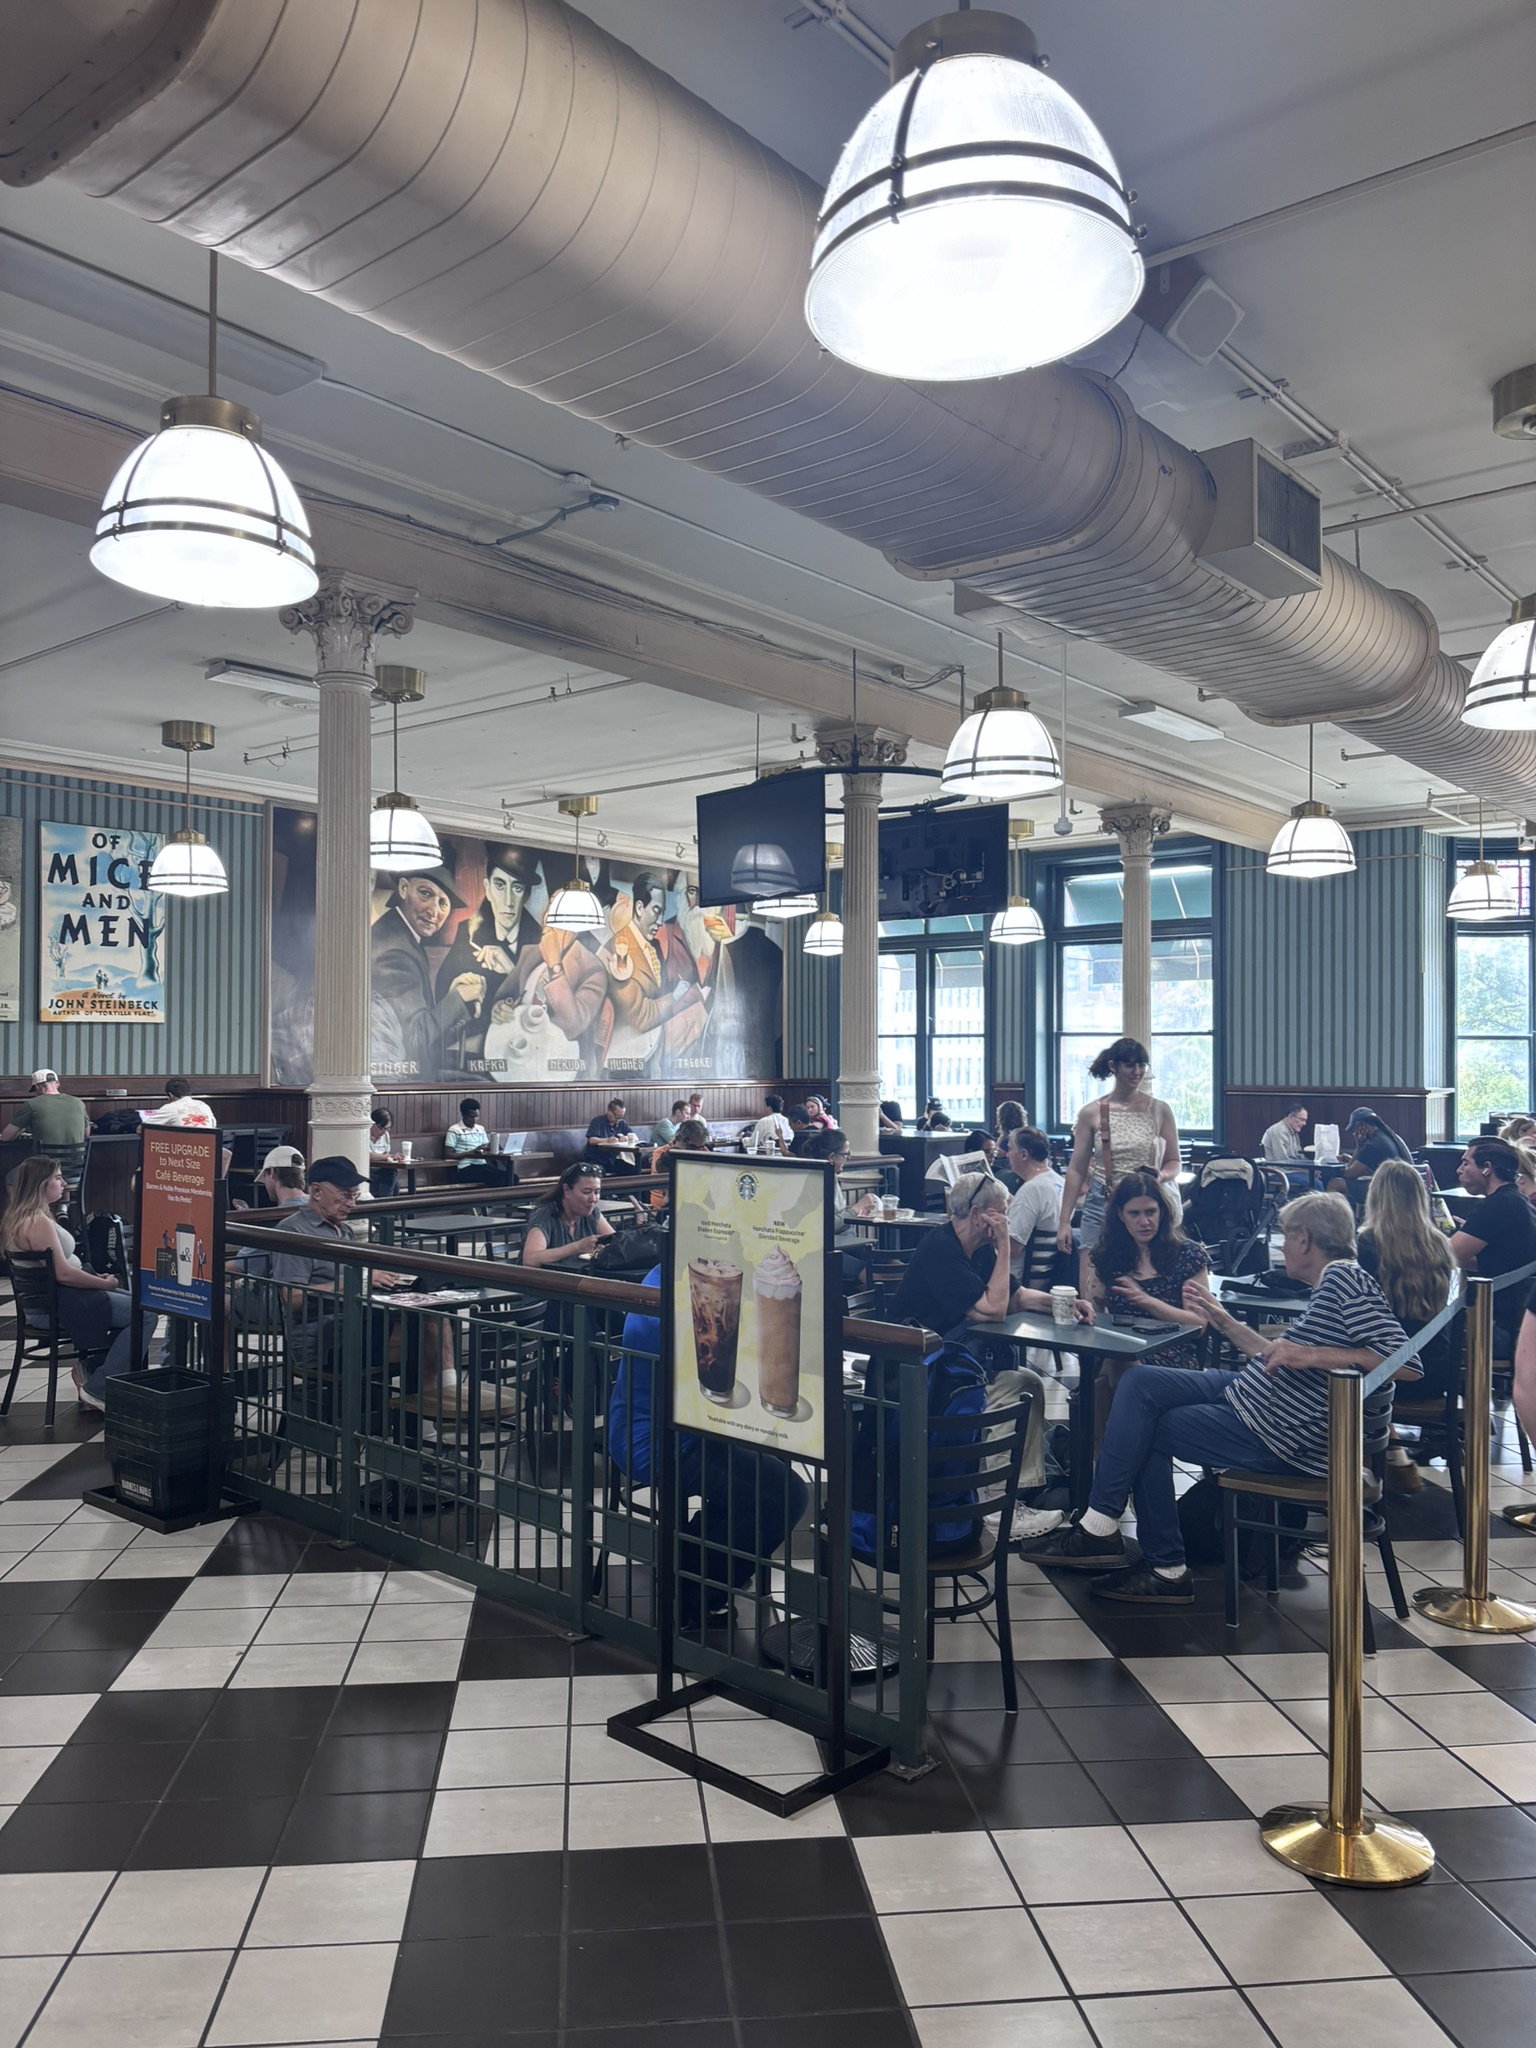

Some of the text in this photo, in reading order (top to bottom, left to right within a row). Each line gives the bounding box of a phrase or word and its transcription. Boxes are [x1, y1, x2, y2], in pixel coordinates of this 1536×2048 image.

[92, 833, 121, 850] OF
[82, 892, 130, 910] AND
[59, 913, 150, 949] MEN
[48, 999, 158, 1010] JOHN STEINBECK
[370, 1061, 419, 1075] SINGER
[470, 1060, 506, 1072] KAFKA
[550, 1059, 587, 1071] NERUDA
[609, 1058, 645, 1070] HUGHES
[677, 1057, 711, 1068] TAGORE
[150, 1142, 210, 1157] FREE UPGRADE
[159, 1157, 200, 1169] to Next Size
[155, 1169, 205, 1186] Café Beverage
[146, 1182, 159, 1190] Barnes
[163, 1184, 174, 1192] Noble
[174, 1185, 190, 1193] Premium
[190, 1188, 213, 1197] Membership
[753, 1225, 774, 1233] Horchata
[758, 1233, 800, 1244] Blended Beverage
